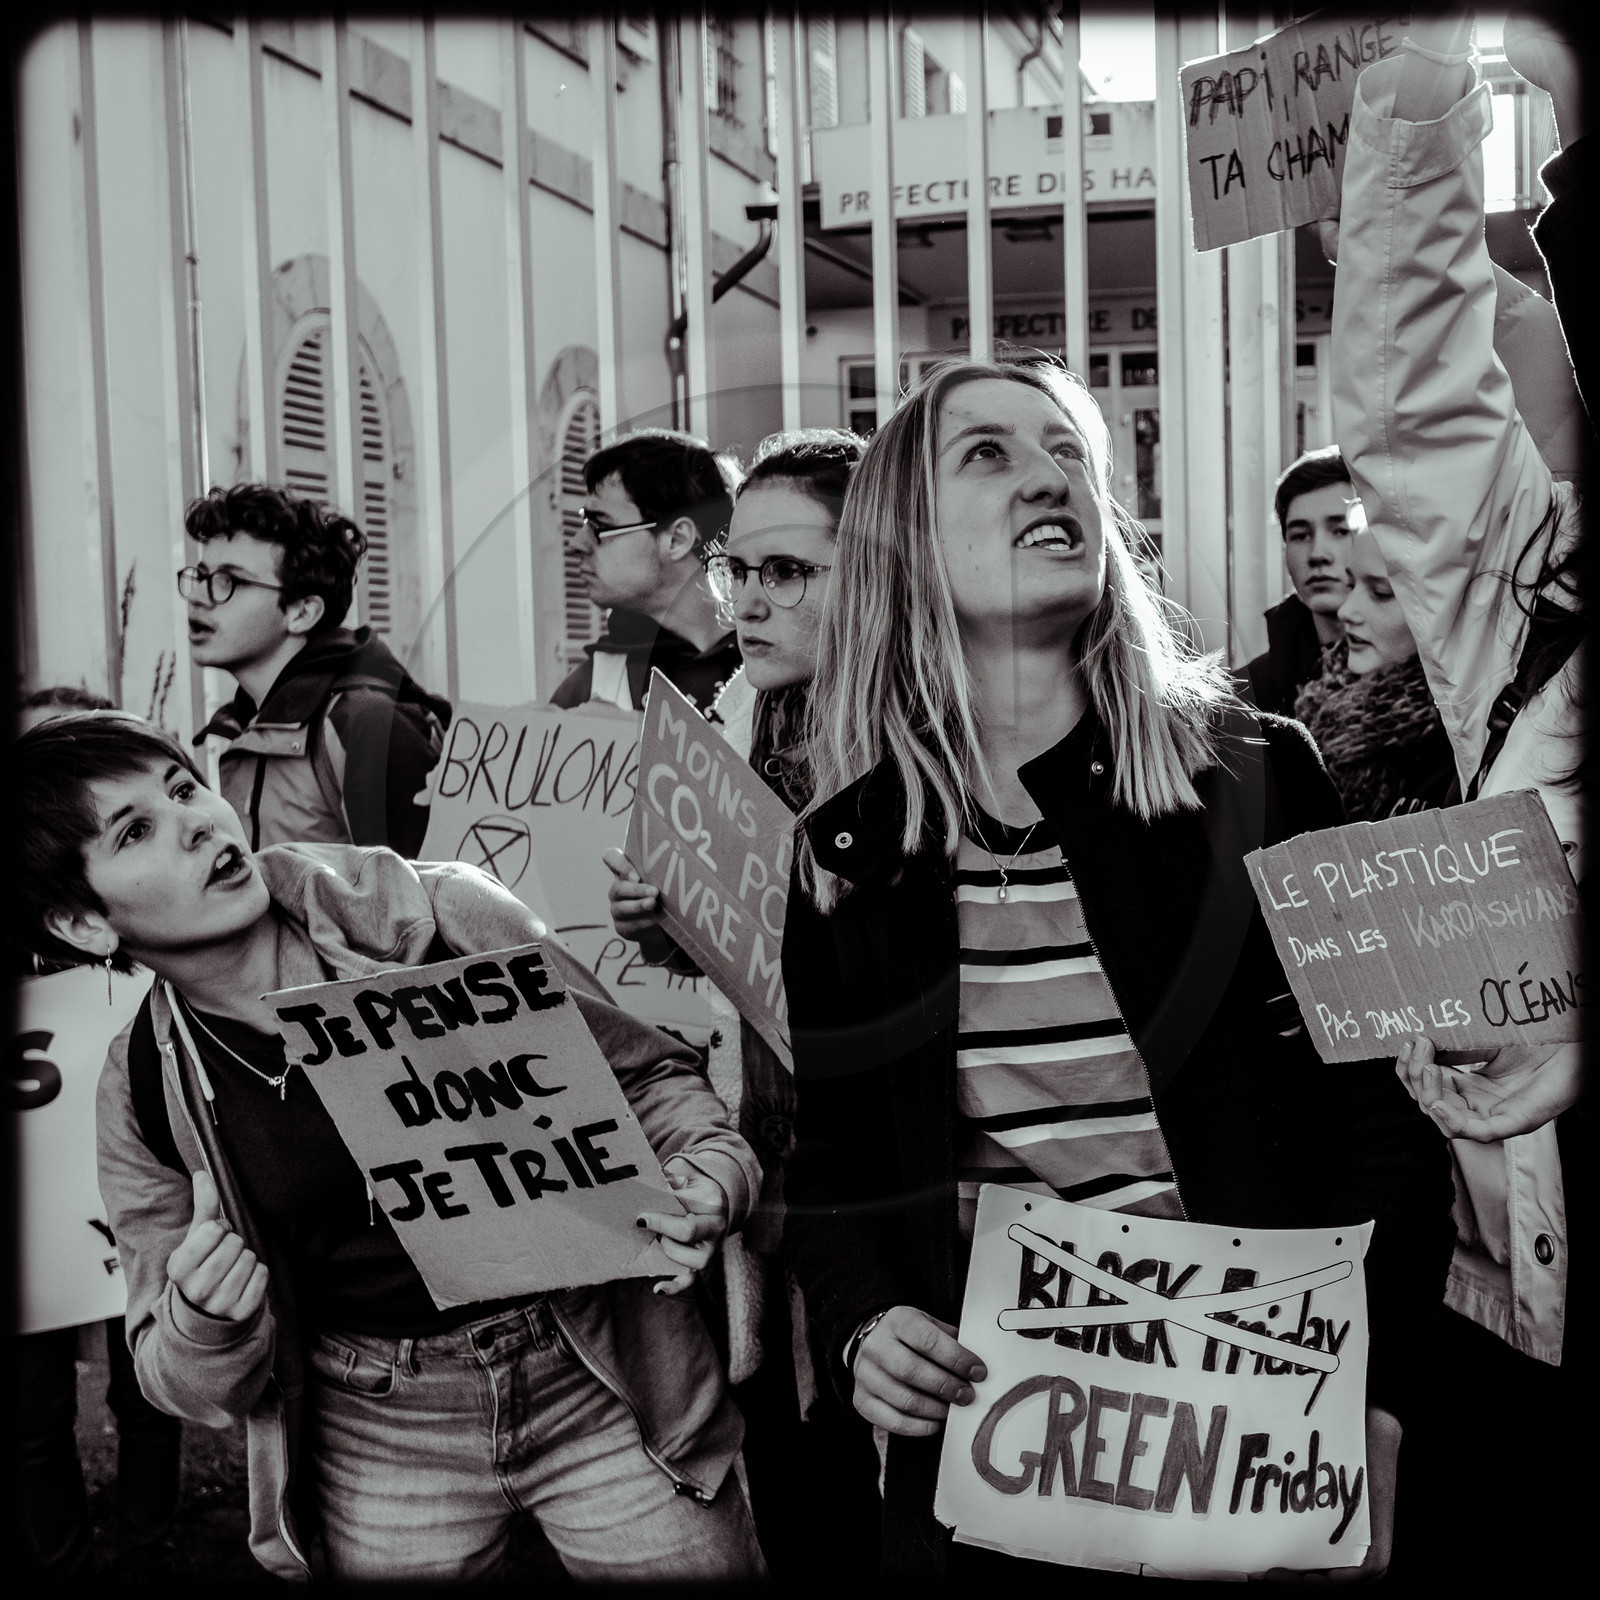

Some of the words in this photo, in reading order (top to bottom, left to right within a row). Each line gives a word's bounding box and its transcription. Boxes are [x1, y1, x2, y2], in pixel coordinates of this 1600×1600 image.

[1294, 17, 1398, 96] RANGE
[838, 174, 1022, 214] PRFECTRE
[1037, 168, 1096, 194] DS
[1200, 149, 1246, 200] TA
[647, 763, 718, 872] CO2
[1258, 866, 1310, 910] LE
[1287, 936, 1342, 967] DANS
[1347, 929, 1388, 954] LES
[352, 951, 568, 1051] PENSE
[1316, 1002, 1361, 1047] PAS
[1365, 1004, 1425, 1040] DANS
[1429, 998, 1472, 1028] LES
[970, 1374, 1229, 1514] GREEN
[1228, 1429, 1365, 1545] Friday
